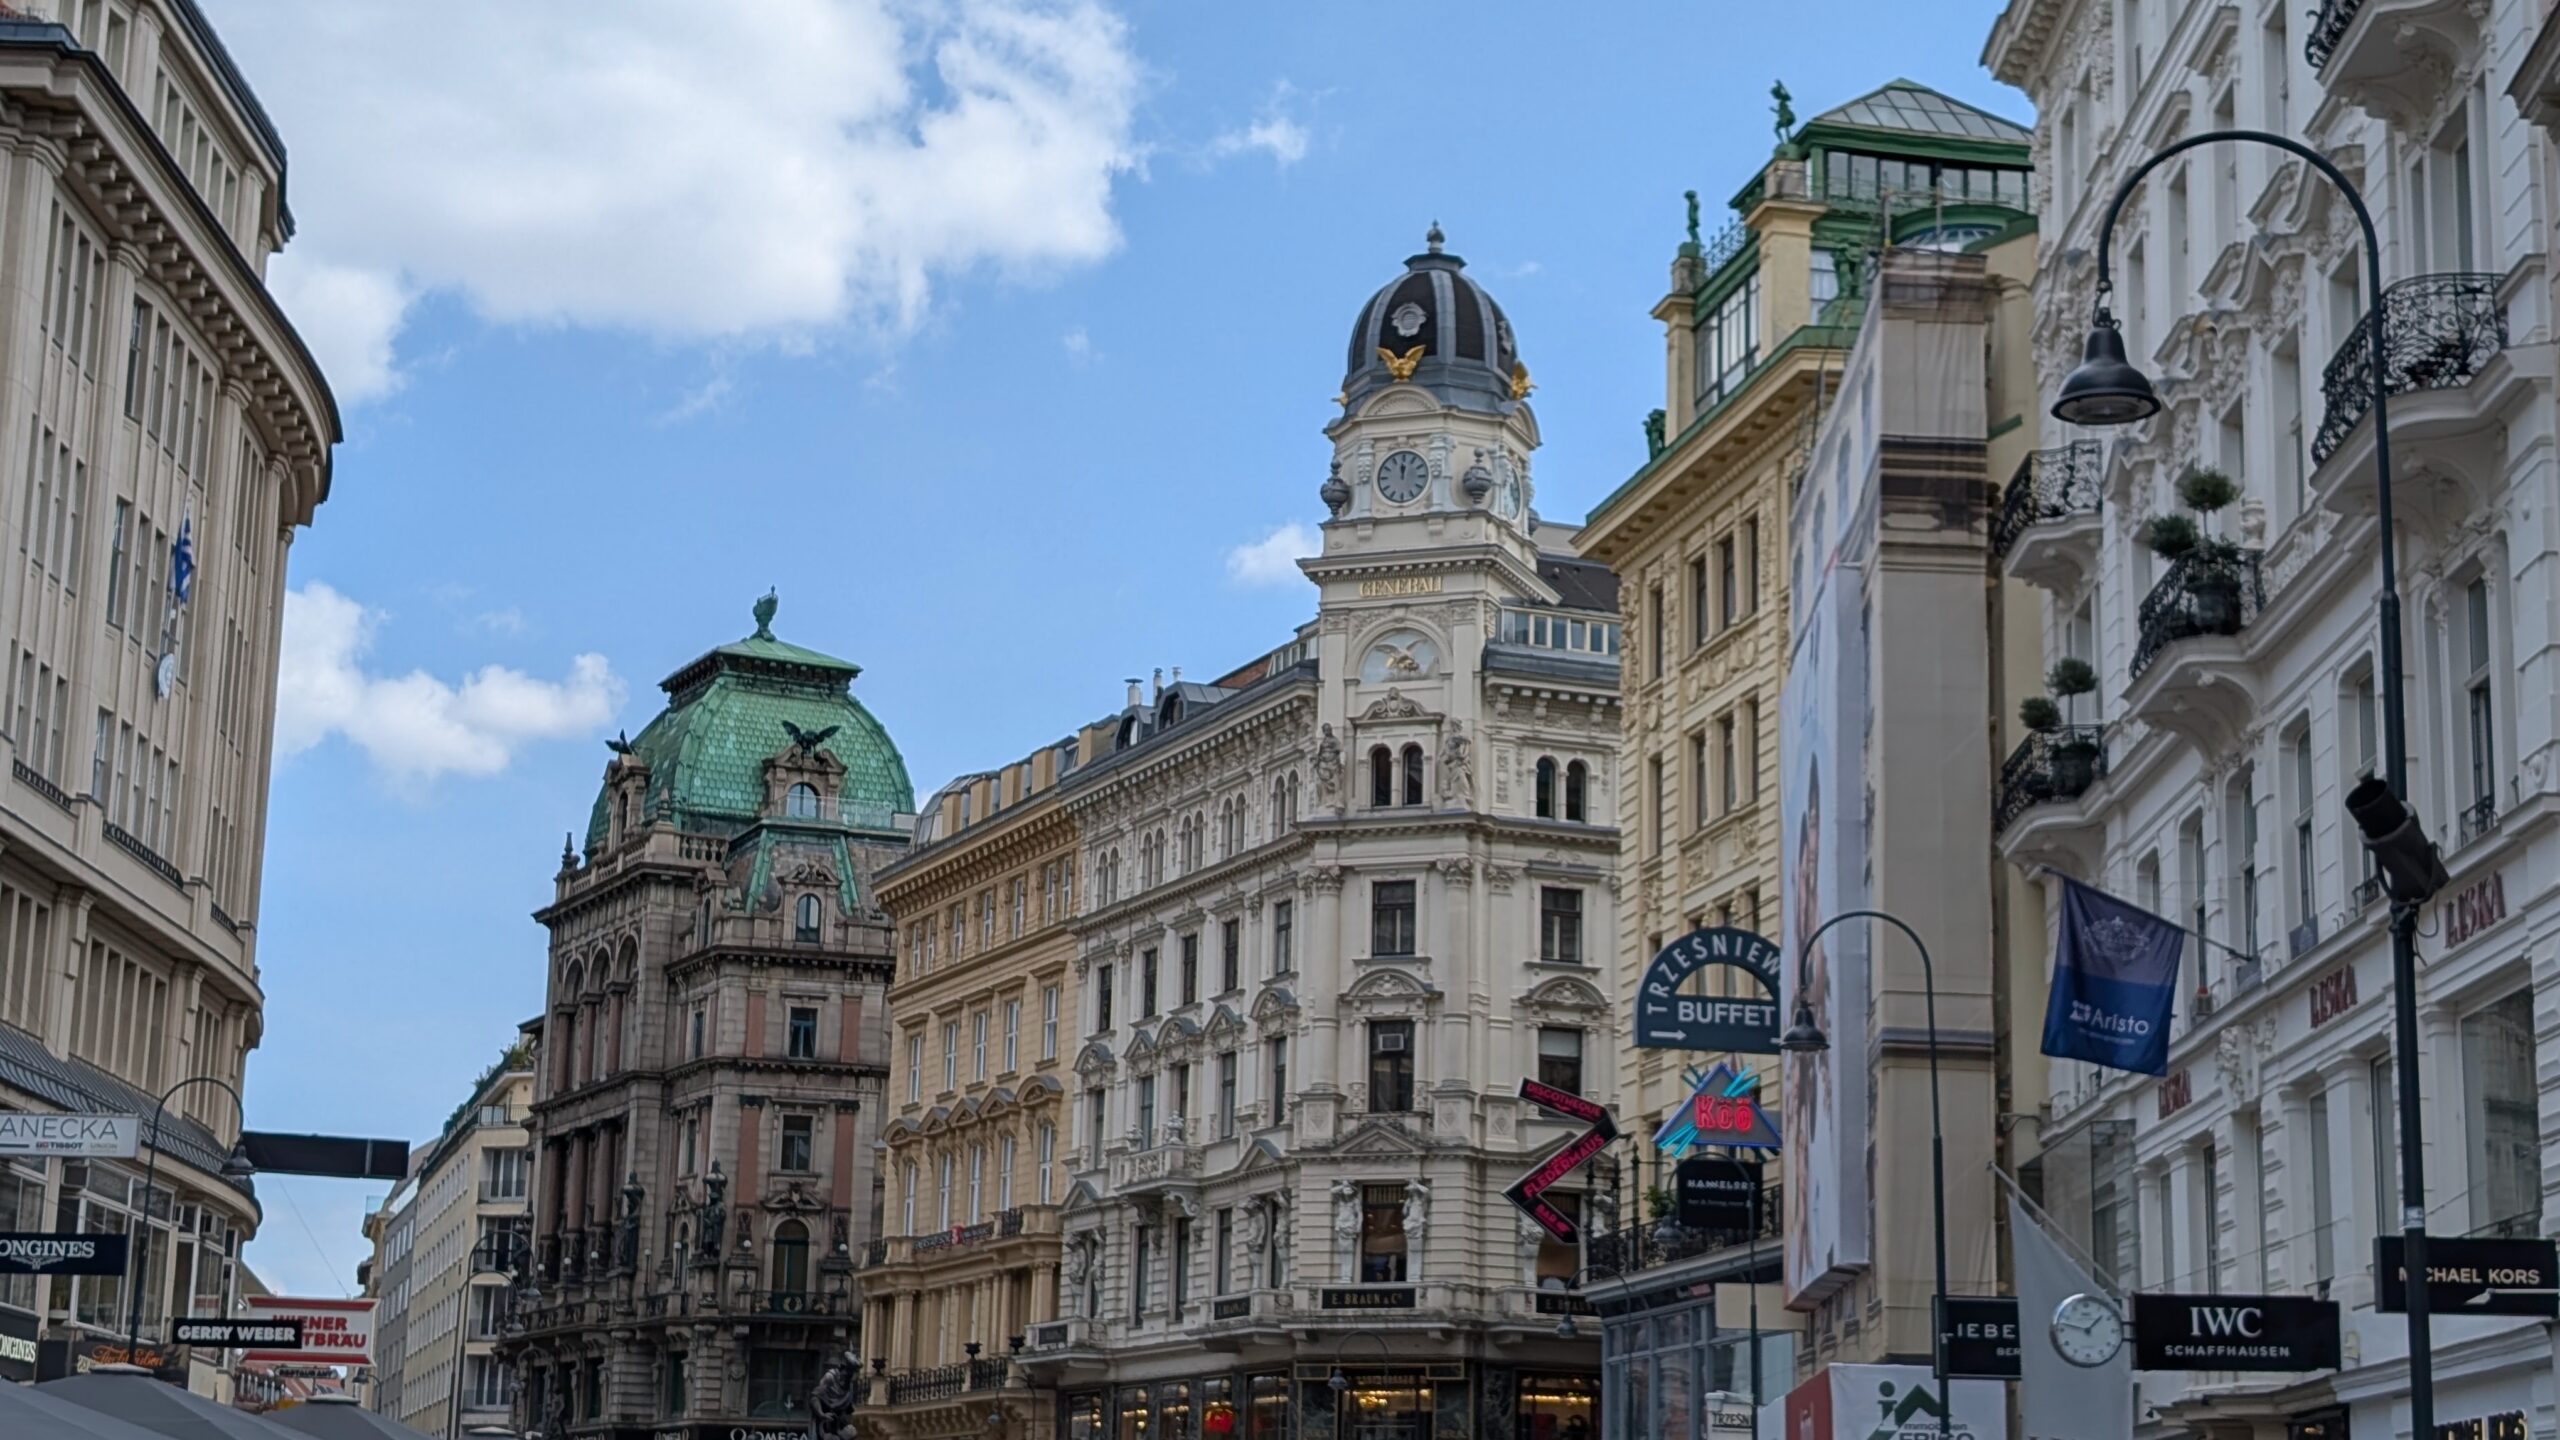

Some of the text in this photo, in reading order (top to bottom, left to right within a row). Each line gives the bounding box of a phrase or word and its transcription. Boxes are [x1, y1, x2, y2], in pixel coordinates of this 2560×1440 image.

[1360, 576, 1443, 597] GENERALI
[2446, 870, 2506, 948] LISKA
[2310, 963, 2358, 1029] LISKA
[1678, 1001, 1776, 1027] BUFFET
[2090, 1008, 2150, 1034] Aristo
[1526, 1082, 1604, 1118] DISCOTHEQUE
[0, 1117, 118, 1140] ANECKA
[1522, 1134, 1606, 1198] FLEDERMAUS
[0, 1240, 95, 1258] ONGINES
[2398, 1266, 2541, 1285] MCHAEL KORS
[178, 1325, 295, 1342] GERRY WEBER
[1946, 1323, 2016, 1338] IEBE
[2190, 1306, 2263, 1338] IWC
[2165, 1345, 2290, 1358] SCHAFFHAUSEN
